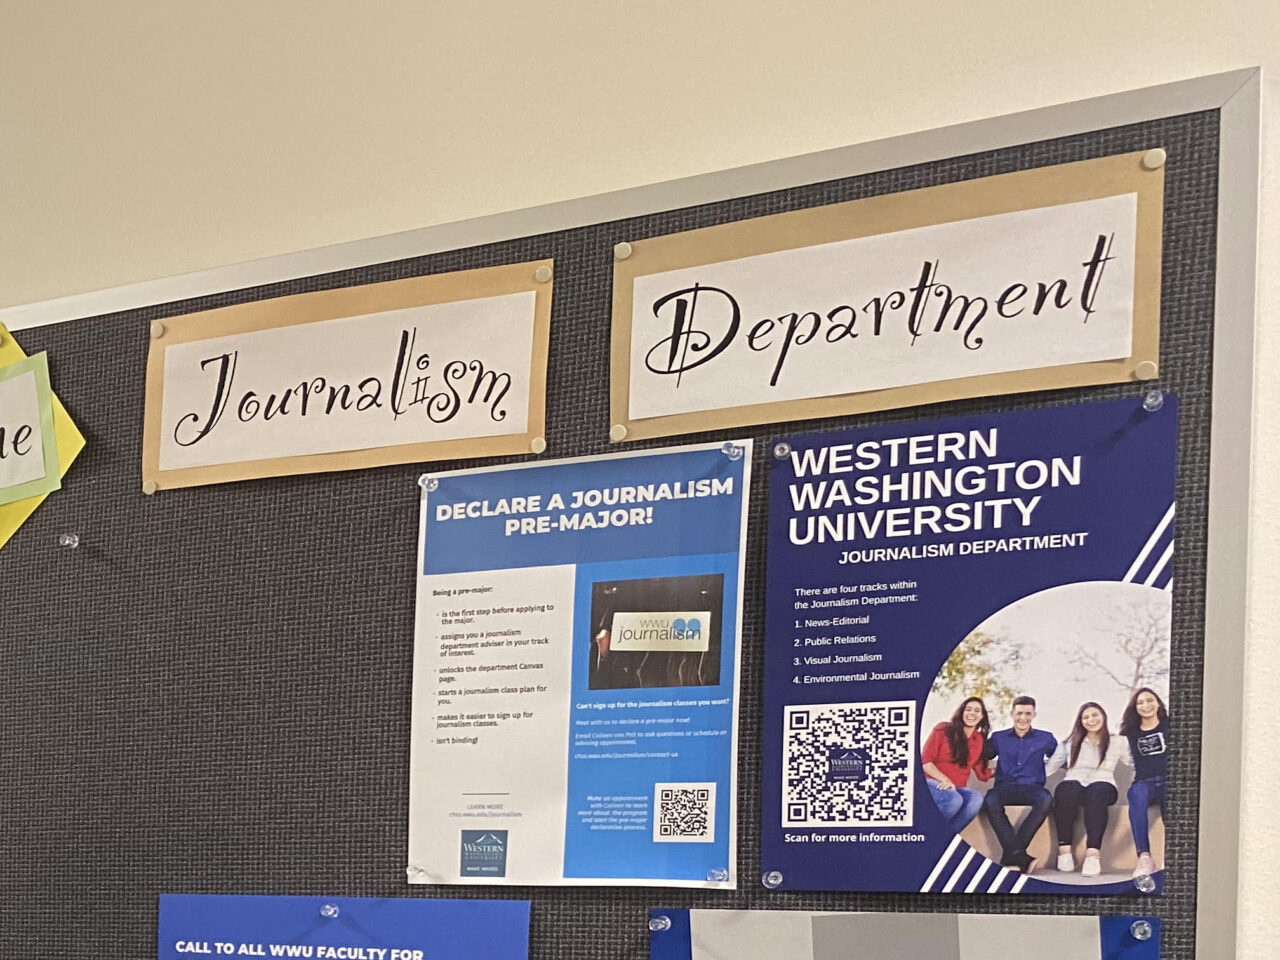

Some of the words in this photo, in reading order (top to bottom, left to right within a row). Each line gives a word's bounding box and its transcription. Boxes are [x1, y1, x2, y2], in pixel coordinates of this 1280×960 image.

[174, 329, 514, 449] Journalism
[644, 233, 1117, 388] Department
[790, 429, 997, 476] WESTERN
[789, 457, 1081, 509] WASHINGTON
[436, 495, 541, 521] DECLARE
[546, 493, 565, 510] A
[570, 478, 733, 508] JOURNALISM
[505, 507, 653, 535] PRE-MAJOR!
[789, 497, 1041, 544] UNIVERSITY
[838, 543, 954, 564] JOURNALISM
[959, 532, 1089, 554] DEPARTMENT
[794, 587, 821, 596] There
[822, 586, 838, 594] are
[839, 584, 858, 593] four
[859, 582, 888, 592] tracks
[889, 580, 917, 589] within
[794, 601, 809, 609] the
[810, 598, 859, 608] Journalism
[861, 594, 918, 605] Department:
[475, 608, 491, 616] step
[515, 605, 545, 613] applying
[640, 619, 669, 627] wwu
[794, 619, 802, 628] 1.
[804, 615, 870, 627] News-Editorial
[618, 626, 700, 643] journalism
[793, 638, 802, 647] 2.
[804, 636, 832, 646] Public
[833, 635, 876, 644] Relations
[793, 657, 802, 666] 3.
[803, 655, 831, 665] Visual
[832, 653, 882, 663] Journalism
[792, 675, 801, 684] 4.
[803, 672, 867, 683] Environmental
[869, 670, 920, 680] Journalism
[784, 833, 809, 842] Scan
[811, 832, 827, 842] for
[828, 834, 857, 842] more
[859, 832, 925, 842] information
[464, 843, 503, 852] WESTERN
[175, 940, 212, 953] CALL
[214, 942, 235, 954] TO
[237, 943, 266, 956] ALL
[269, 944, 313, 957] WWU
[316, 946, 387, 960] FACULTY
